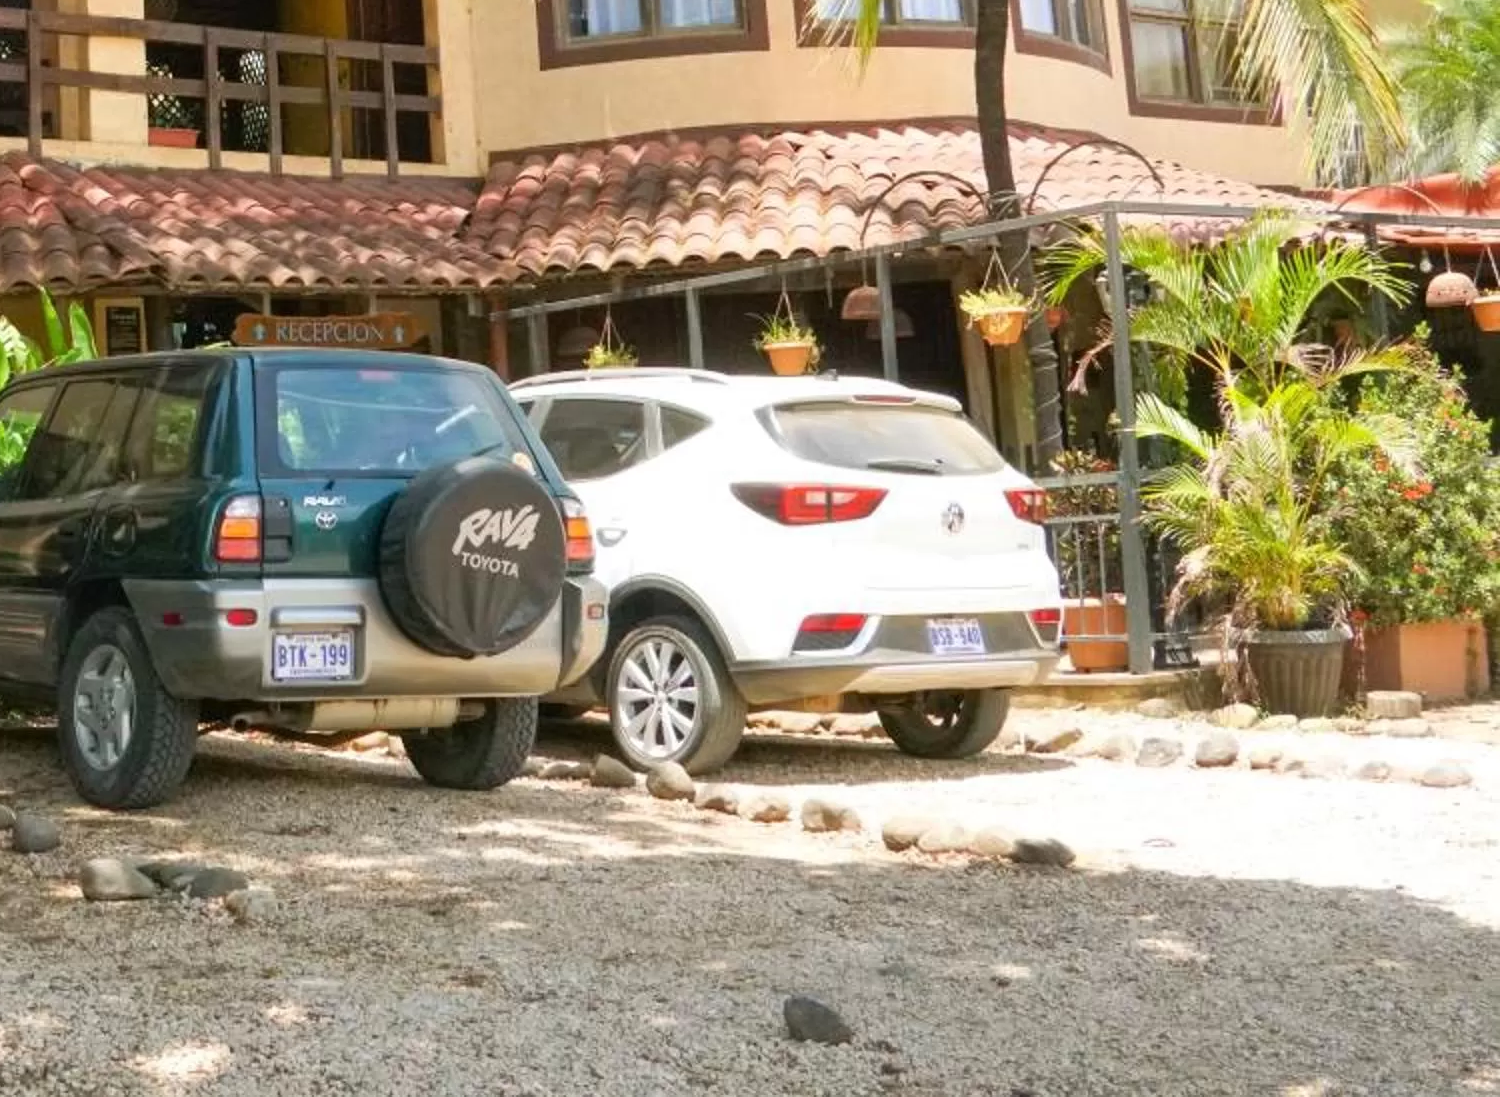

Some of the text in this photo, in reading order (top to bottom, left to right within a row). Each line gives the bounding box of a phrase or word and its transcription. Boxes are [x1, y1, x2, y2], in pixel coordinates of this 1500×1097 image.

[275, 321, 384, 343] RECEPCION
[452, 504, 540, 555] RAV4
[461, 551, 519, 579] TOYOTA
[278, 644, 348, 668] BTK-199
